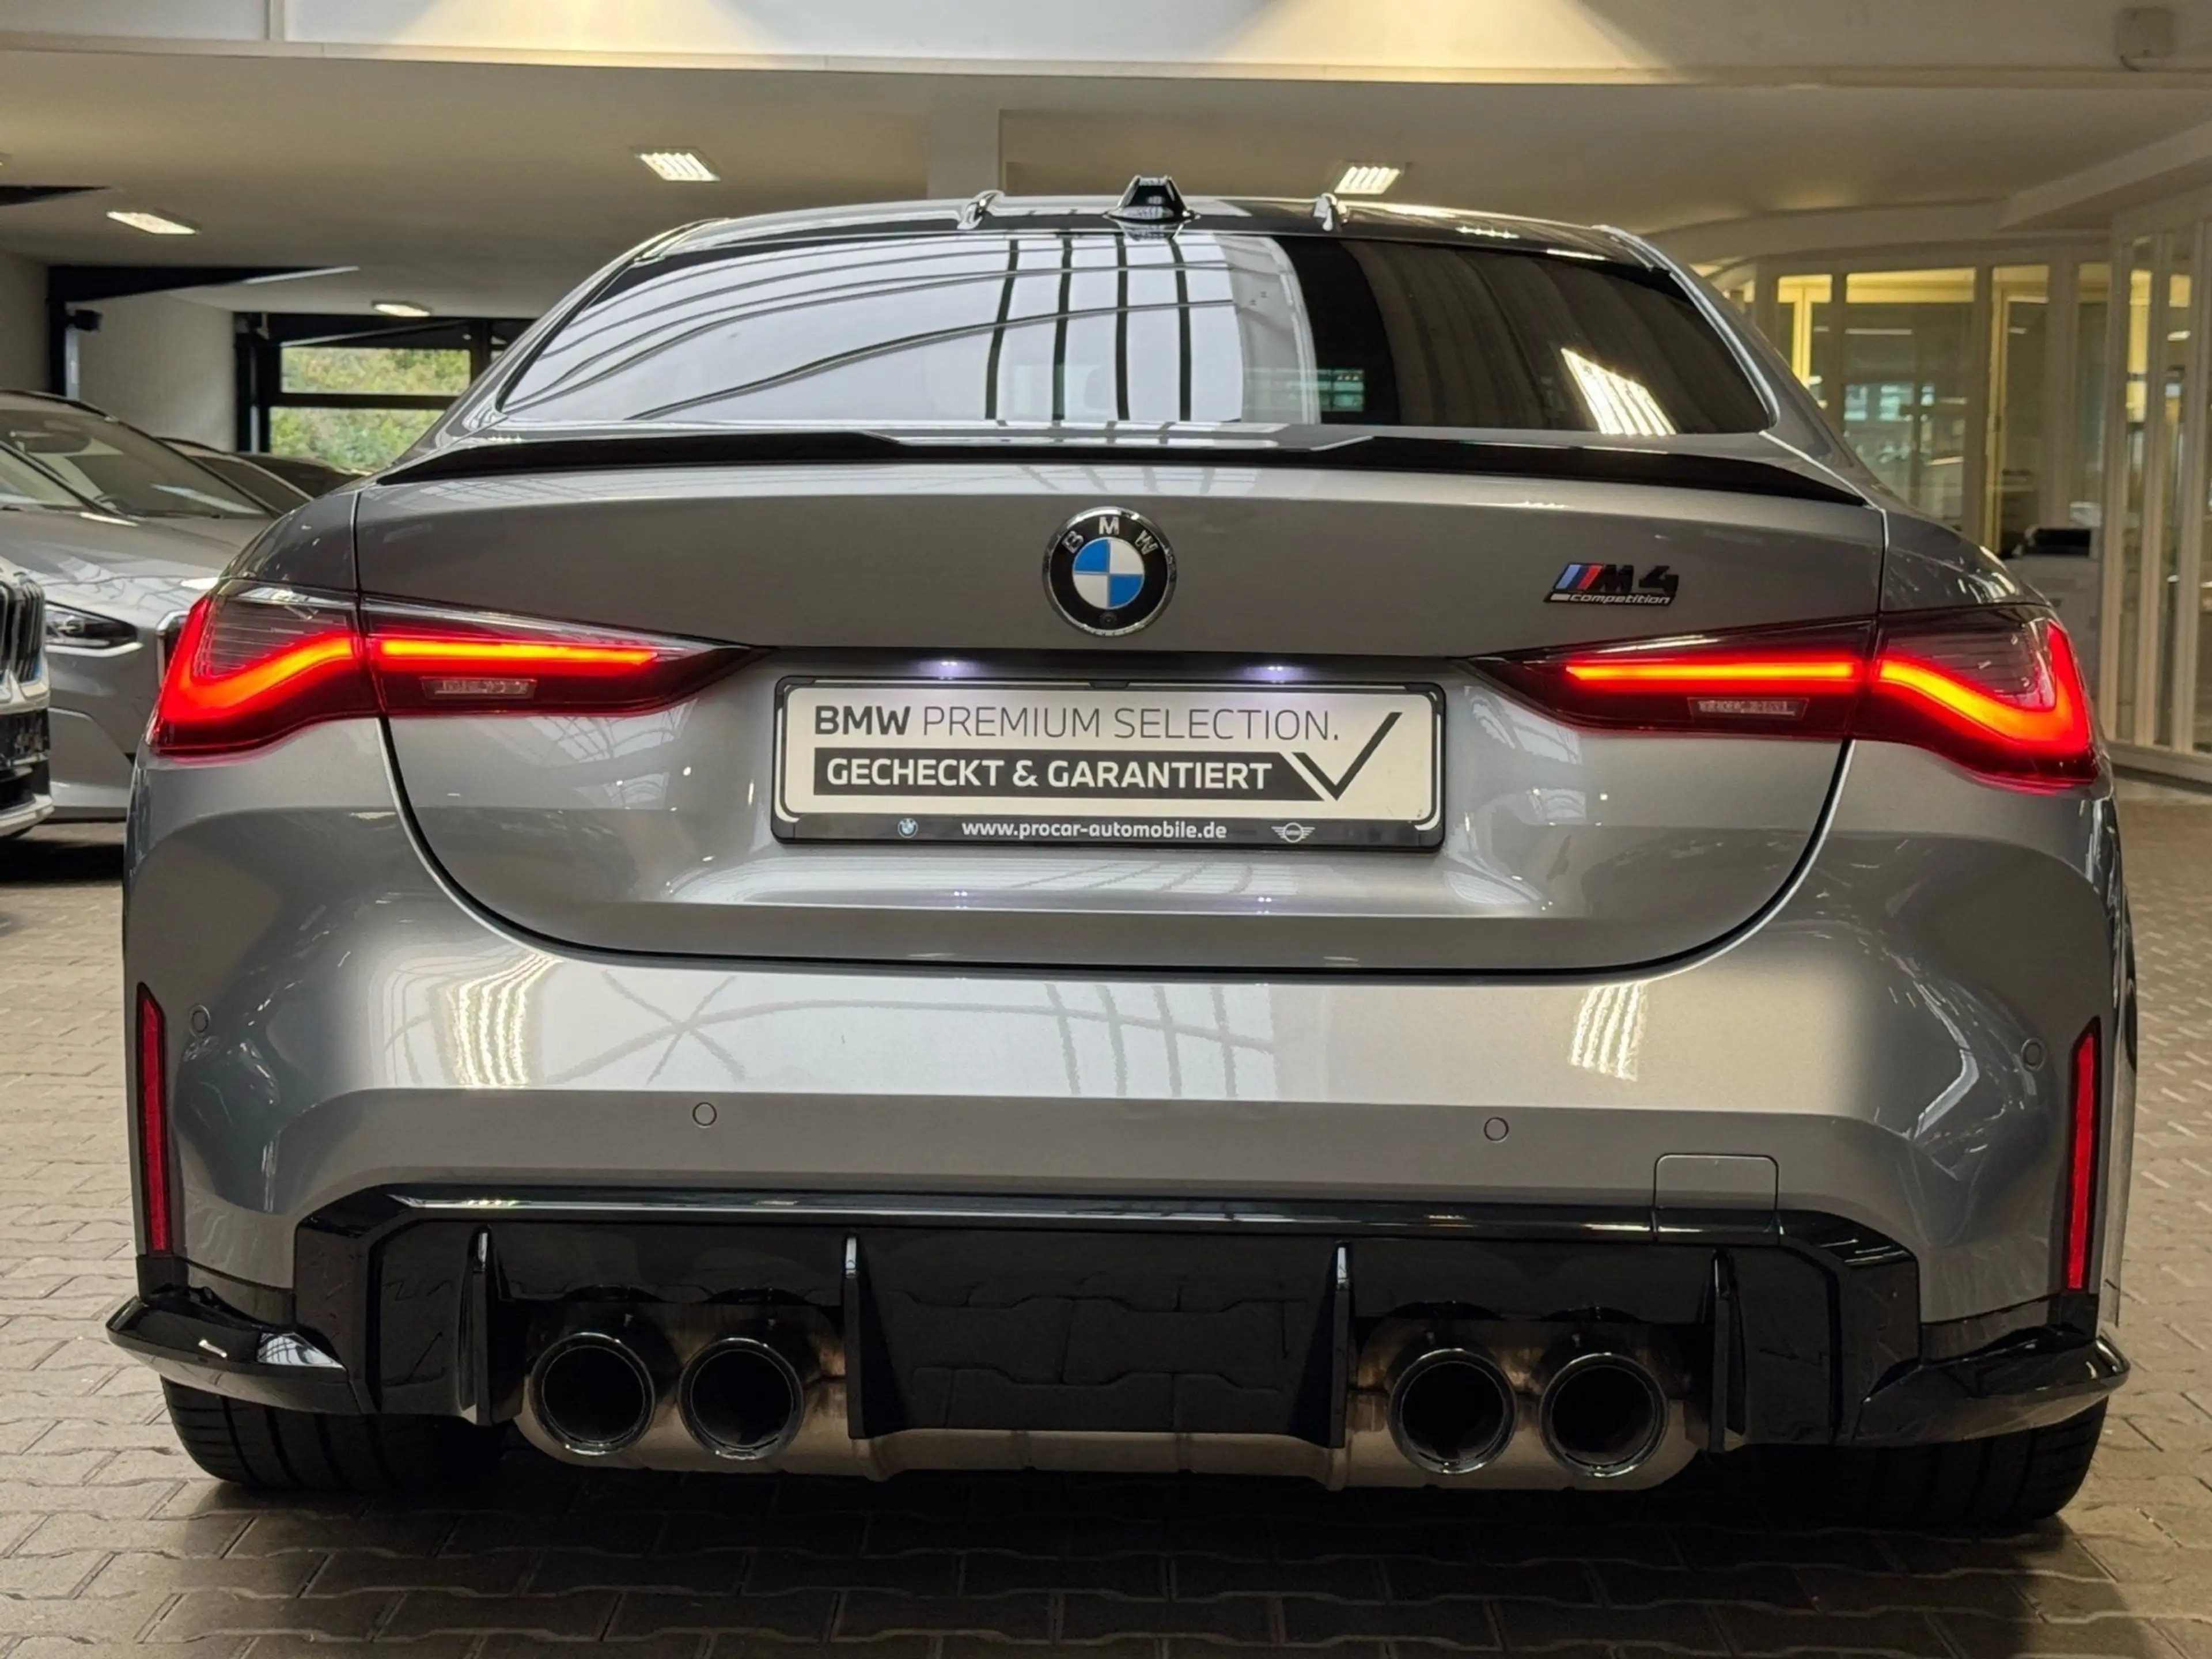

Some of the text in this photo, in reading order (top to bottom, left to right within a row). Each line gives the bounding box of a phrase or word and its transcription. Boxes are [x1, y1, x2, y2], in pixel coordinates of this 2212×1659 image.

[1060, 516, 1158, 555] BMW
[1585, 565, 1679, 596] M4
[815, 706, 1339, 741] BMW PREMIUM SELECTION.
[827, 757, 1272, 790] GECHECKT & GARANTIERT
[963, 821, 1228, 839] www.procar-automobile.de
